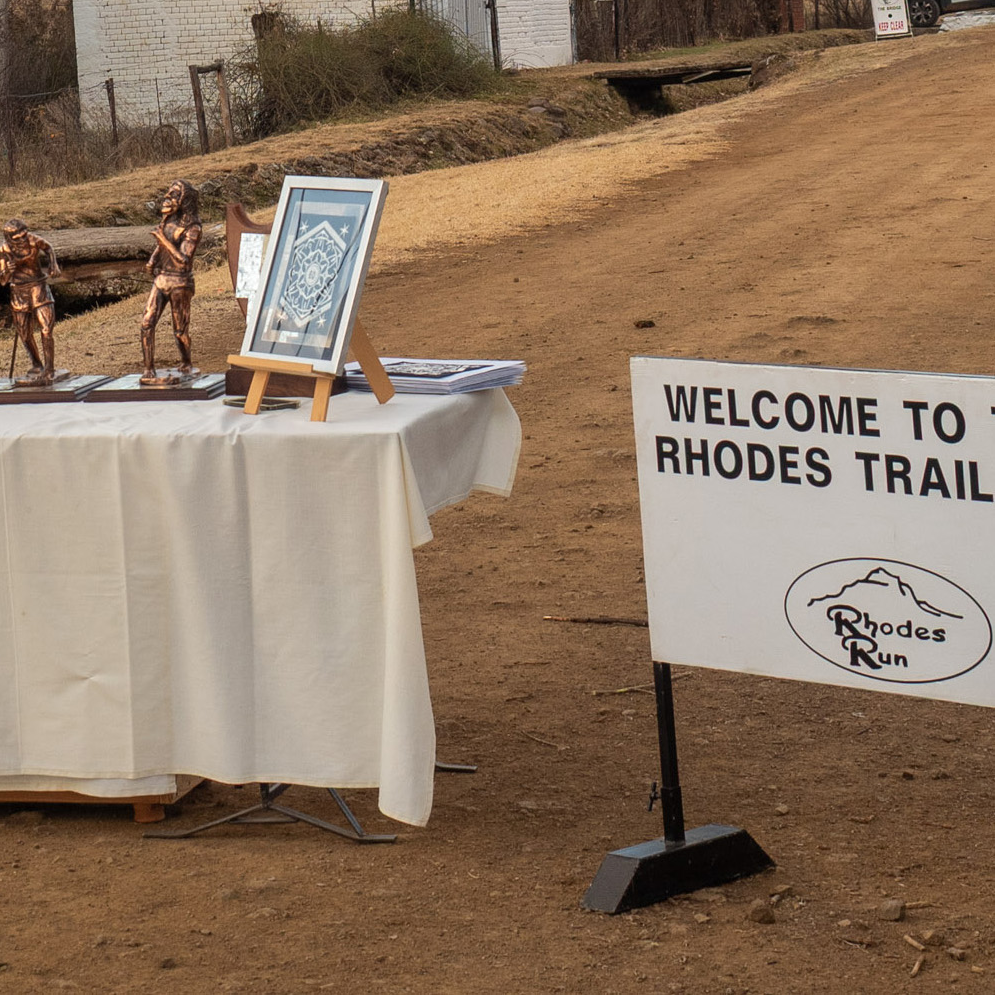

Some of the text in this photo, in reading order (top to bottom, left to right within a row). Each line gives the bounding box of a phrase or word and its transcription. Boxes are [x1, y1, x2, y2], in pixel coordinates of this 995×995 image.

[879, 21, 904, 31] KEEP CLEAR
[663, 384, 966, 444] WELCOME TO
[655, 435, 994, 503] RHODES TRAIL
[826, 604, 947, 644] Rhodes
[842, 636, 909, 670] Run
